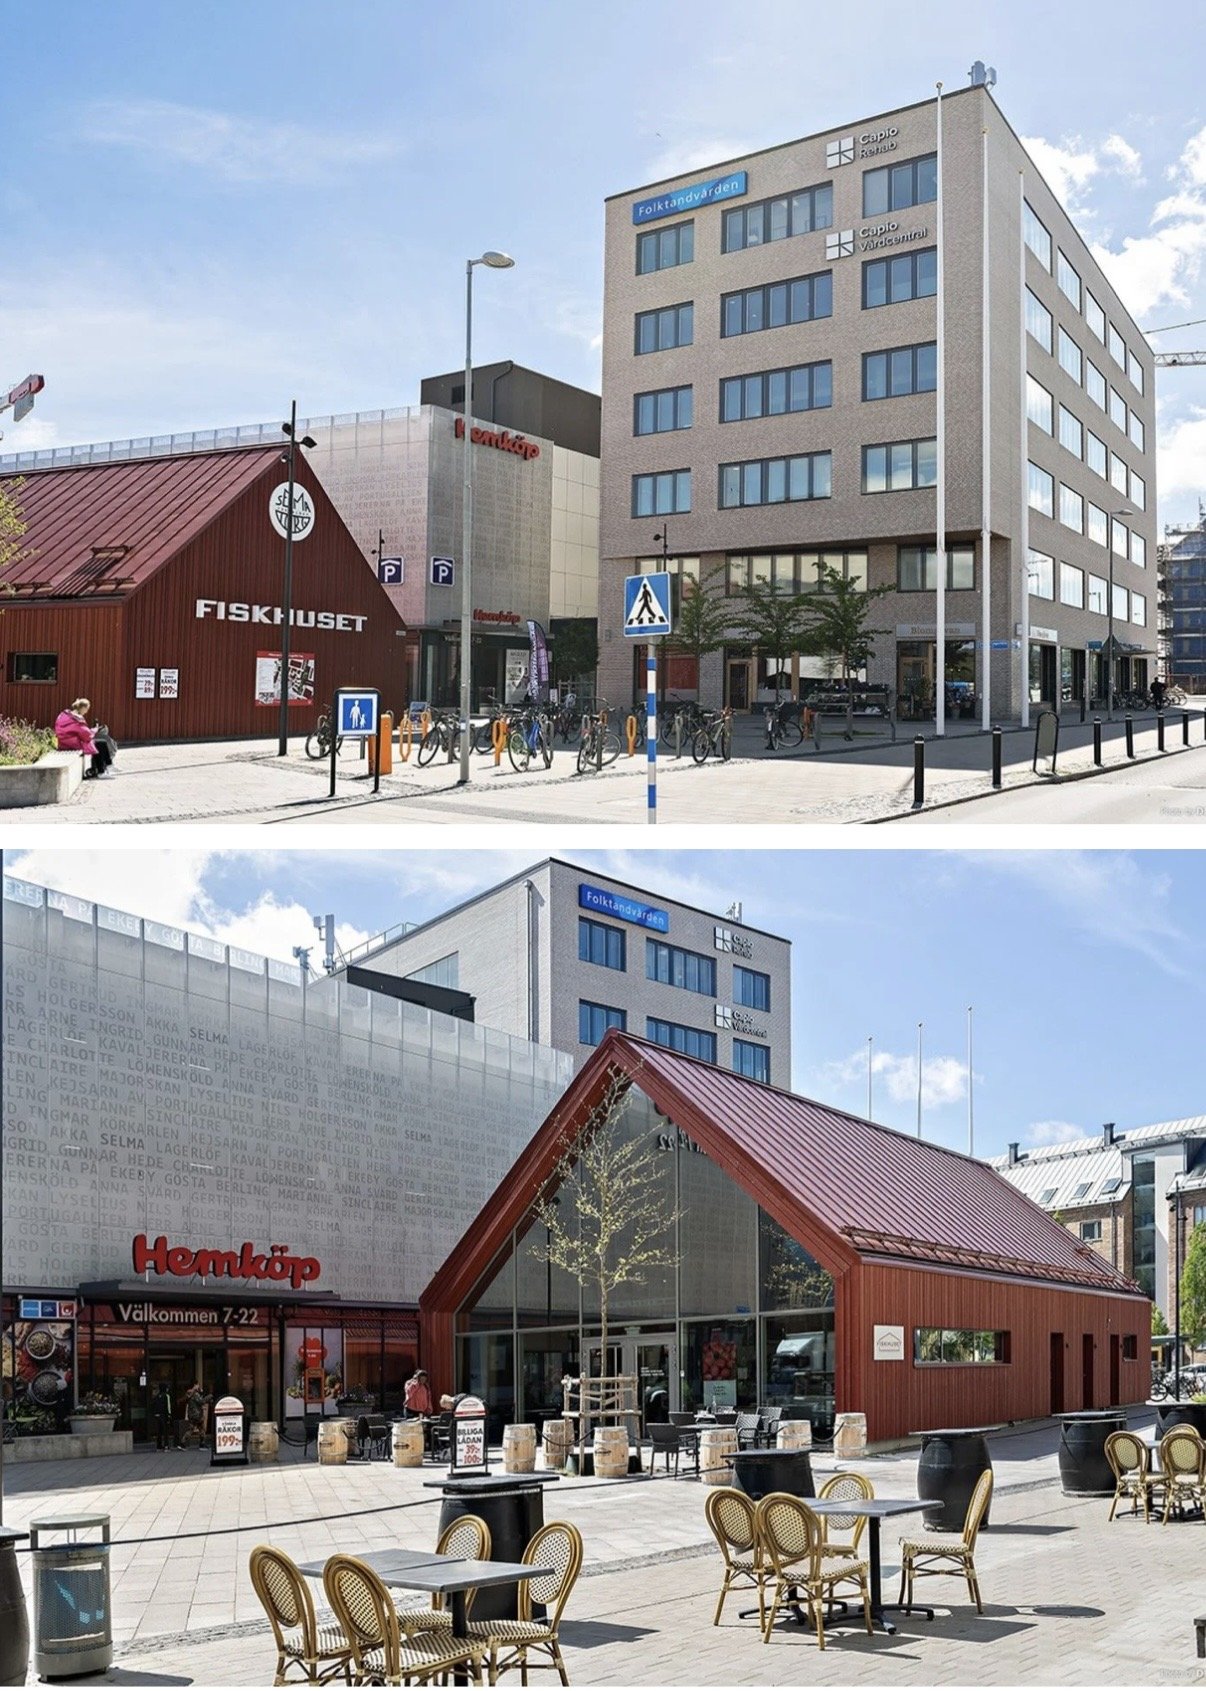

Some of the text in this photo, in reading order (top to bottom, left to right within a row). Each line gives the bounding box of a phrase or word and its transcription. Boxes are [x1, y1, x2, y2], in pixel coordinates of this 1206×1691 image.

[859, 126, 898, 145] Capio
[859, 139, 897, 160] Rehab
[638, 180, 739, 216] Folktandvården
[859, 221, 898, 238] Capio
[859, 226, 928, 252] Vårdcentral
[275, 487, 311, 513] SEMA
[384, 565, 396, 582] P
[439, 565, 449, 582] P
[195, 598, 368, 632] FISKHUSET
[586, 891, 664, 926] Folktandvården
[733, 934, 754, 949] Capio
[36, 988, 135, 1025] HOLGERSSON
[145, 1015, 179, 1035] AKKA
[189, 1026, 229, 1047] SELMA
[733, 1010, 755, 1025] Capio
[37, 1005, 77, 1027] ARNE
[89, 1017, 143, 1042] INGRID
[153, 1032, 204, 1056] GUNNAR
[213, 1047, 245, 1065] HEDE
[27, 1036, 115, 1067] CHARLOTTE
[127, 1055, 213, 1087] LÖWENSKÖLD
[222, 1078, 254, 1096] ANNA
[98, 1036, 206, 1071] KAVALJERERNA
[239, 1067, 276, 1086] EKEBY
[327, 1087, 372, 1106] BERLING
[49, 1075, 118, 1100] KEJSARN
[127, 1090, 143, 1104] AV
[155, 1095, 254, 1124] PORTUGALLIEN
[298, 1122, 326, 1137] ARNE
[99, 1068, 180, 1096] MAJORSKAN
[190, 1086, 254, 1110] LYSELIUS
[261, 1100, 290, 1117] NILS
[298, 1108, 366, 1131] HOLGERSSON
[404, 1129, 431, 1143] SELMA
[28, 1104, 89, 1127] INGMAR
[99, 1113, 179, 1141] KÖRKARLEN
[190, 1131, 247, 1152] KEJSARN
[254, 1142, 269, 1155] AV
[277, 1145, 359, 1169] PORTUGALLIEN
[59, 1093, 136, 1118] MARIANNE
[147, 1108, 221, 1133] SINCLAIRE
[231, 1123, 298, 1146] MAJORSKAN
[306, 1136, 360, 1156] LYSELIUS
[100, 1132, 145, 1151] SELMA
[155, 1138, 221, 1162] LAGERLÖF
[231, 1152, 320, 1176] KAVALJERERNA
[347, 1170, 379, 1185] EKEBY
[128, 1152, 163, 1169] HEDE
[79, 1158, 98, 1176] PÅ
[109, 1165, 156, 1183] EKEBY
[163, 1170, 206, 1189] GÖSTA
[216, 1179, 269, 1197] BERLING
[277, 1187, 333, 1204] MARIANNE
[341, 1195, 397, 1212] SINCLAIRE
[89, 1179, 128, 1195] ANNA
[137, 1182, 181, 1201] SVÄRD
[191, 1191, 248, 1209] GERTRUD
[7, 1203, 127, 1227] PORTUGALLIEN
[49, 1191, 127, 1211] LYSELIUS
[135, 1200, 172, 1216] NILS
[307, 1219, 341, 1232] SELMA
[18, 1219, 69, 1238] GÖSTA
[132, 1233, 321, 1289] Hemköp
[118, 1302, 259, 1324] Välkommen 7-22
[217, 1435, 242, 1447] 199:-
[457, 1427, 484, 1436] BILLIGA
